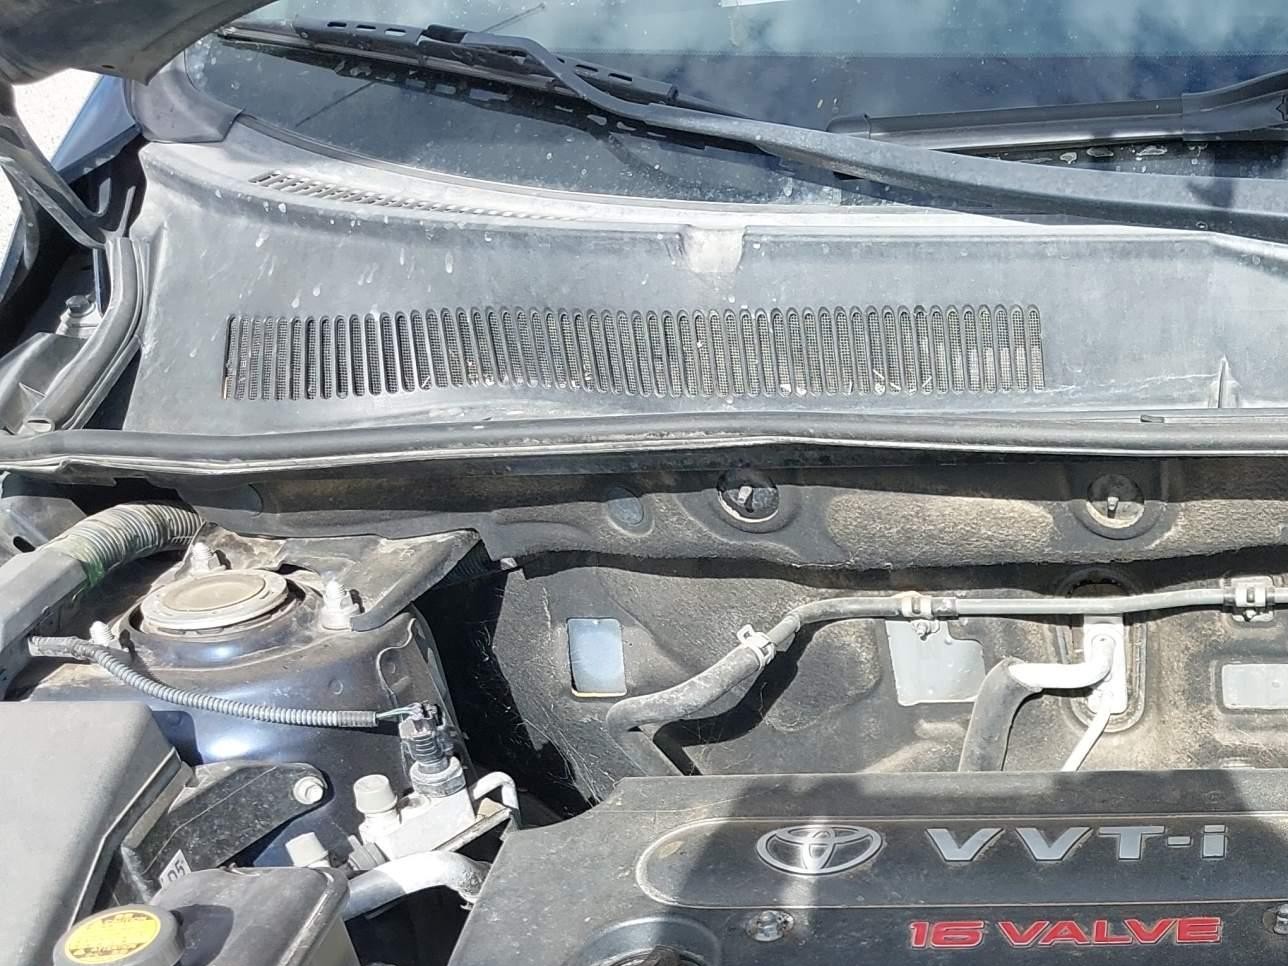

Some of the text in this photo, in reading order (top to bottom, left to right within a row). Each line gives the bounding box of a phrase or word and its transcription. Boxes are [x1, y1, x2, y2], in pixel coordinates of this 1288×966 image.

[926, 824, 1228, 862] VVT-i
[909, 916, 1222, 948] 16 VALVE
